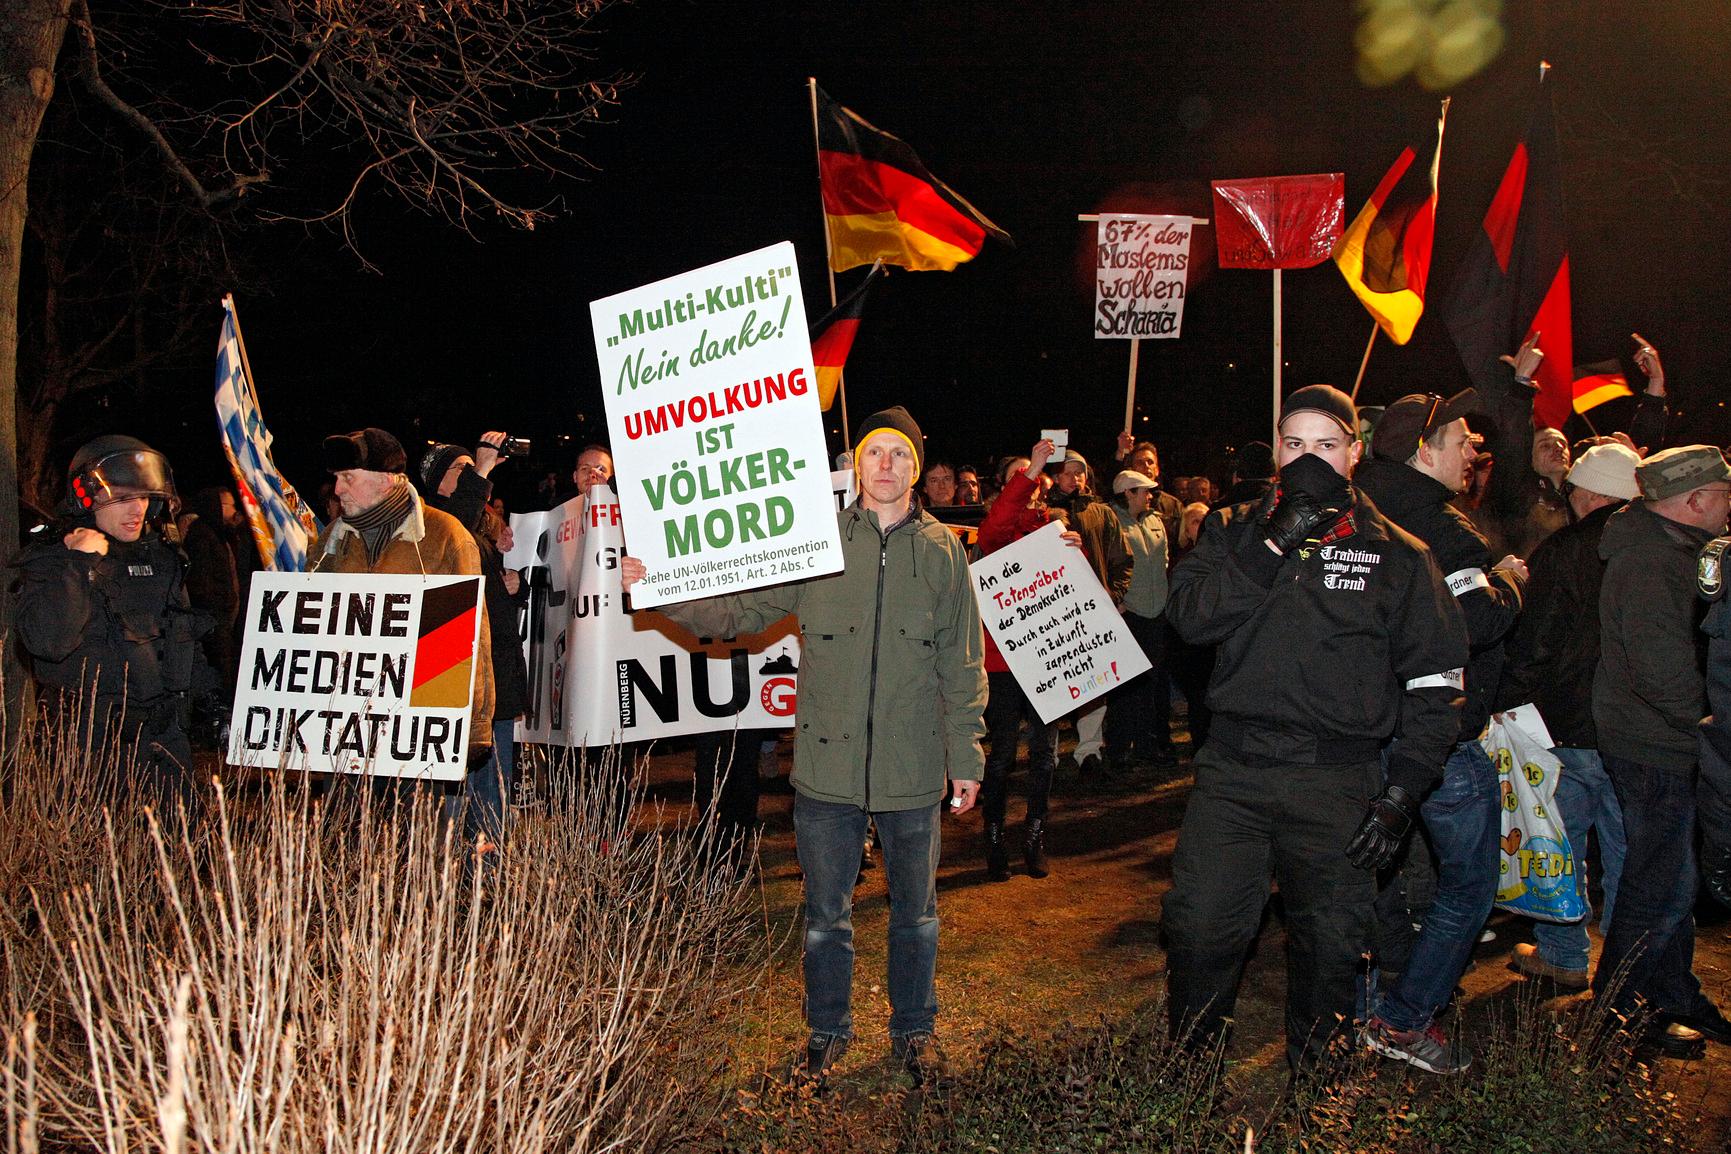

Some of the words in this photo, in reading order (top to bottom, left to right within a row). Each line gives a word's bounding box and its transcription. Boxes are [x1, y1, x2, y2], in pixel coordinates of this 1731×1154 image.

[1105, 220, 1152, 243] 67%
[1154, 223, 1189, 245] der
[1098, 241, 1189, 270] Moslems
[1098, 270, 1184, 299] wollen
[617, 348, 680, 395] Nein
[689, 294, 792, 367] danke!
[624, 368, 808, 440] UMVOLKUNG
[696, 423, 735, 456] IST
[641, 447, 806, 511] VÖLKER-
[663, 496, 794, 558] MORD
[673, 540, 829, 579] UN-Völkerrechtskonvention
[1320, 546, 1380, 564] Tradition
[657, 585, 681, 597] vom
[684, 572, 744, 591] 12.01.1951,
[747, 569, 768, 580] Art.
[771, 564, 777, 575] 2
[780, 559, 804, 573] Abs.
[807, 557, 814, 567] C
[980, 575, 998, 591] An
[1002, 562, 1022, 578] die
[993, 565, 1065, 610] Totengräber
[1324, 574, 1366, 591] Trend
[258, 590, 412, 637] KEINE
[998, 616, 1015, 631] der
[1016, 583, 1075, 620] Demokratie:
[1005, 629, 1037, 651] Durch
[1038, 616, 1060, 634] euch
[1062, 602, 1081, 621] wird
[1084, 599, 1096, 611] es
[1035, 646, 1047, 658] in
[1045, 620, 1087, 651] Zukunft
[1045, 630, 1117, 671] zappenduster,
[250, 647, 408, 699] MEDIEN
[1035, 676, 1057, 694] aber
[1063, 654, 1094, 681] nicht
[1068, 661, 1120, 700] bunter!
[619, 663, 631, 725] NÜRNBERG
[243, 706, 464, 764] DIKTATUR!
